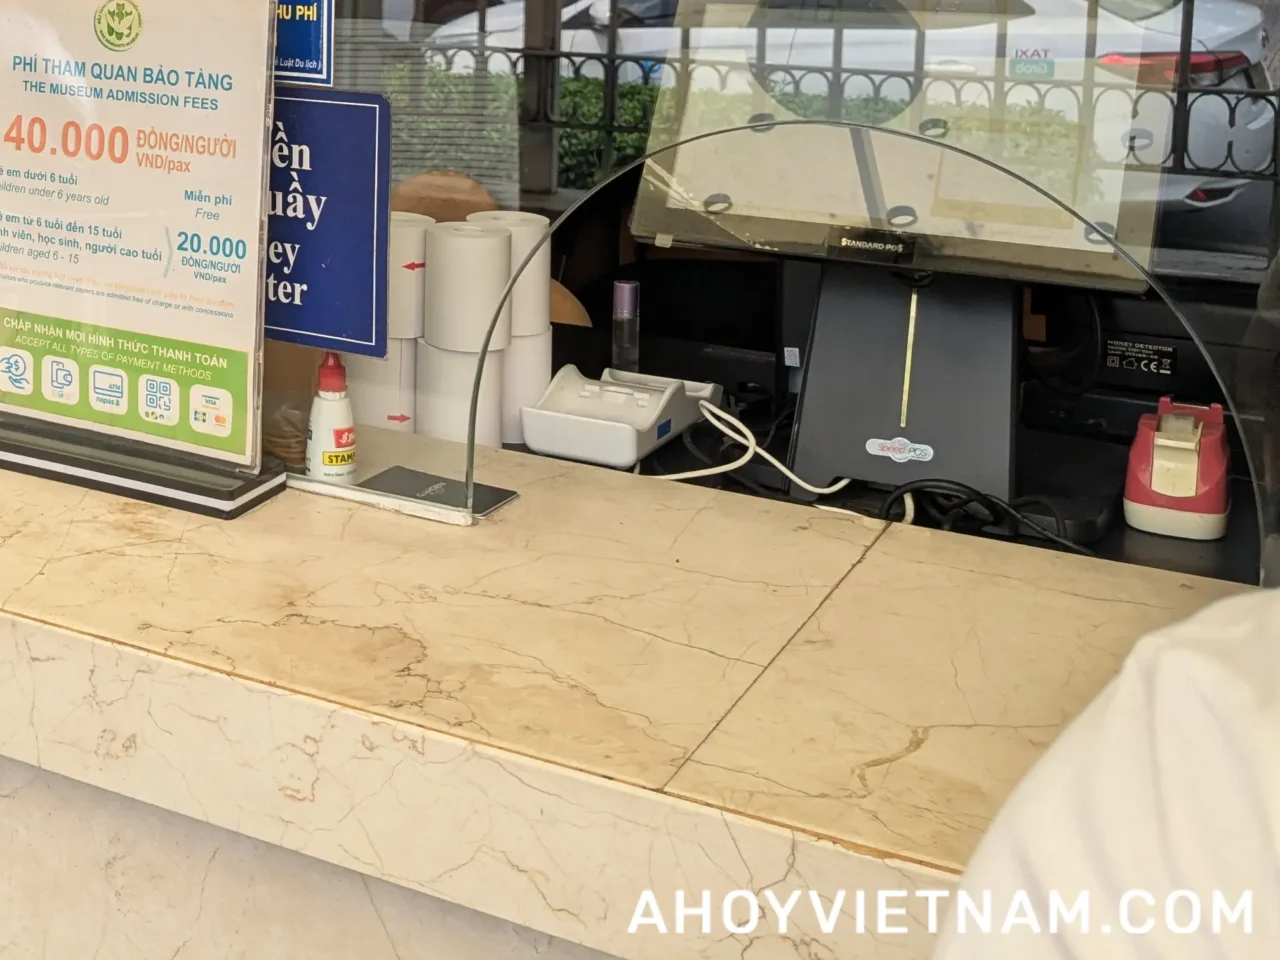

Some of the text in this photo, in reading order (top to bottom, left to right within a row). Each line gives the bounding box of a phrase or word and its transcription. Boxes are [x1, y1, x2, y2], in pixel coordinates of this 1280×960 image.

[296, 2, 317, 21] PHÍ
[12, 53, 234, 91] PHÍ THAM QUAN BẢO TÀNG
[295, 58, 305, 68] Du
[22, 80, 219, 111] THE MUSEUM ADMISSION FEES
[3, 114, 237, 164] 40.000 ĐỒNG/NGƯỜI
[136, 152, 191, 174] VND/pax
[6, 168, 21, 178] em
[23, 169, 47, 182] dưới
[50, 172, 56, 183] 6
[58, 173, 78, 186] tuổi
[28, 185, 56, 199] under
[57, 189, 64, 199] 6
[65, 192, 92, 204] years
[94, 195, 110, 206] old
[184, 189, 233, 207] Miễn phí
[195, 207, 220, 221] Free
[5, 214, 20, 224] em
[23, 215, 35, 226] từ
[36, 217, 42, 227] 6
[44, 218, 63, 231] tuổi
[65, 220, 84, 234] đến
[87, 225, 99, 236] 15
[102, 226, 123, 240] tuổi
[11, 229, 35, 243] viên,
[37, 232, 56, 246] học
[58, 237, 82, 251] sinh,
[85, 241, 117, 255] người
[119, 247, 139, 258] cao
[141, 248, 163, 262] tuổi
[176, 231, 247, 260] 20.000
[841, 237, 904, 253] STANDARD POS
[27, 247, 51, 260] aged
[52, 250, 59, 261] 6
[69, 253, 80, 264] 15
[181, 256, 241, 274] ĐỒNG/NGƯỜI
[194, 271, 227, 284] VND/pax
[29, 279, 52, 288] produce
[52, 283, 75, 292] relevant
[75, 287, 95, 296] papers
[106, 291, 131, 301] admitted
[132, 295, 143, 303] free
[152, 300, 173, 309] charge
[182, 304, 194, 312] with
[195, 306, 234, 319] concessions
[65, 329, 86, 344] MỌI
[88, 332, 115, 348] HÌNH
[117, 338, 149, 354] THỨC
[151, 345, 192, 363] THANH
[194, 352, 228, 369] TOÁN
[1134, 343, 1173, 352] DETECTOR
[14, 335, 212, 381] ACCEPT ALL TYPES OF PAYMENT METHODS
[96, 396, 115, 405] napas
[908, 447, 928, 456] POS
